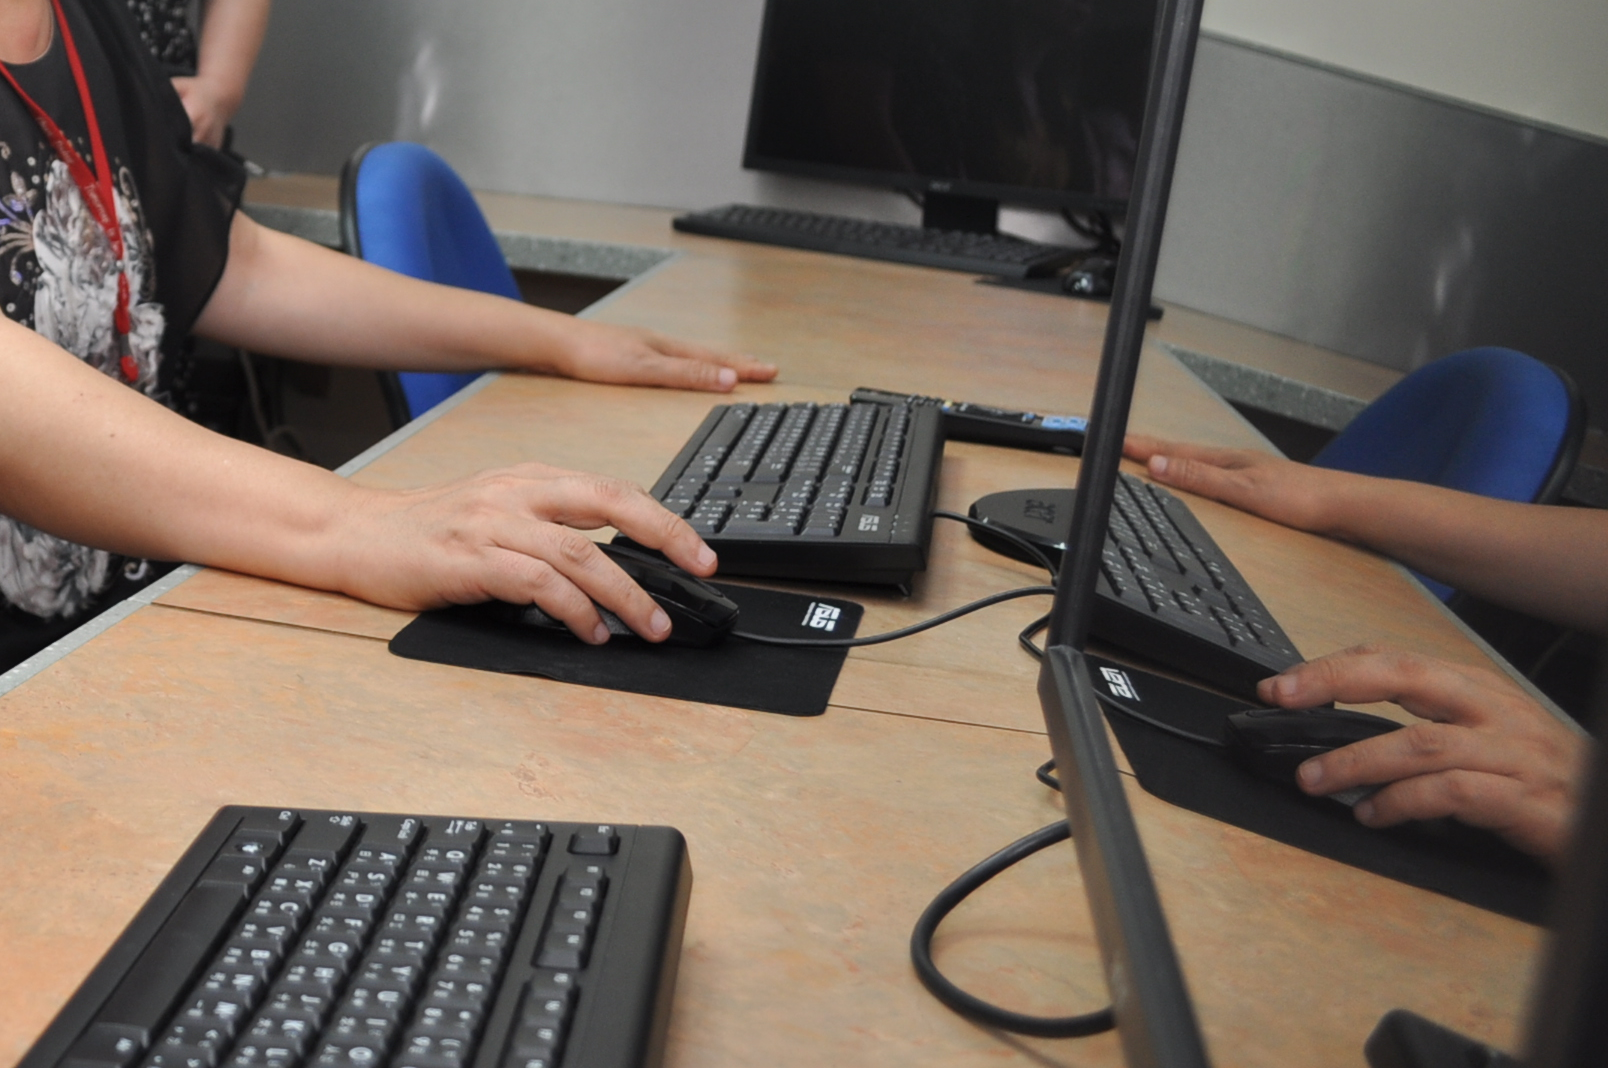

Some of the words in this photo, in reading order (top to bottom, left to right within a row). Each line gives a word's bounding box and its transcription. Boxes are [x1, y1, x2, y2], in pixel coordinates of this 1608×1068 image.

[379, 852, 396, 861] A
[446, 850, 464, 859] Q
[308, 858, 326, 867] Z
[368, 872, 385, 880] S
[437, 872, 456, 882] W
[295, 879, 313, 888] X
[356, 894, 374, 903] D
[280, 902, 299, 914] C
[344, 918, 363, 927] F
[266, 926, 286, 936] V
[404, 941, 424, 949] T
[391, 966, 411, 975] Y
[301, 995, 321, 1003] J
[377, 990, 399, 1002] U
[349, 1047, 373, 1061] O
